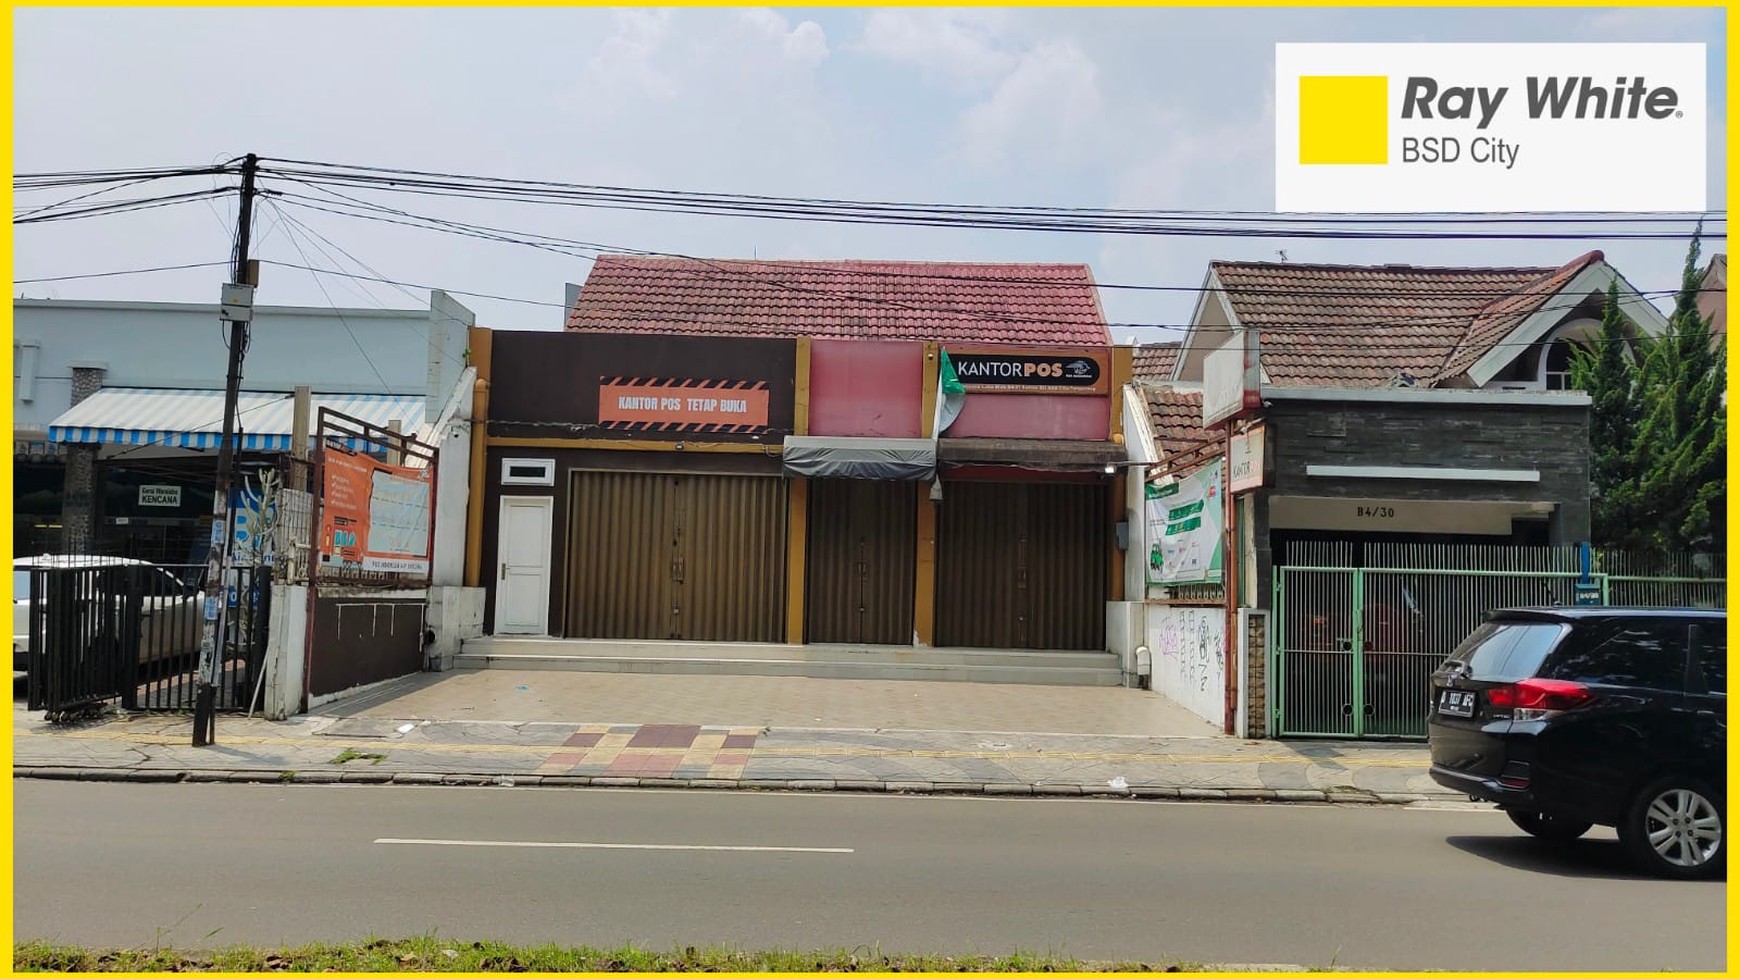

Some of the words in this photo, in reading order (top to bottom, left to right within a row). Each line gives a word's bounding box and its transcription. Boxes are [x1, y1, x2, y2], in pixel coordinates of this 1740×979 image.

[618, 396, 658, 410] KANTOR
[661, 398, 681, 411] POS
[687, 398, 717, 412] TETAP
[720, 400, 747, 413] BUKA
[141, 495, 177, 504] KENCANA
[1357, 506, 1394, 518] B4/30
